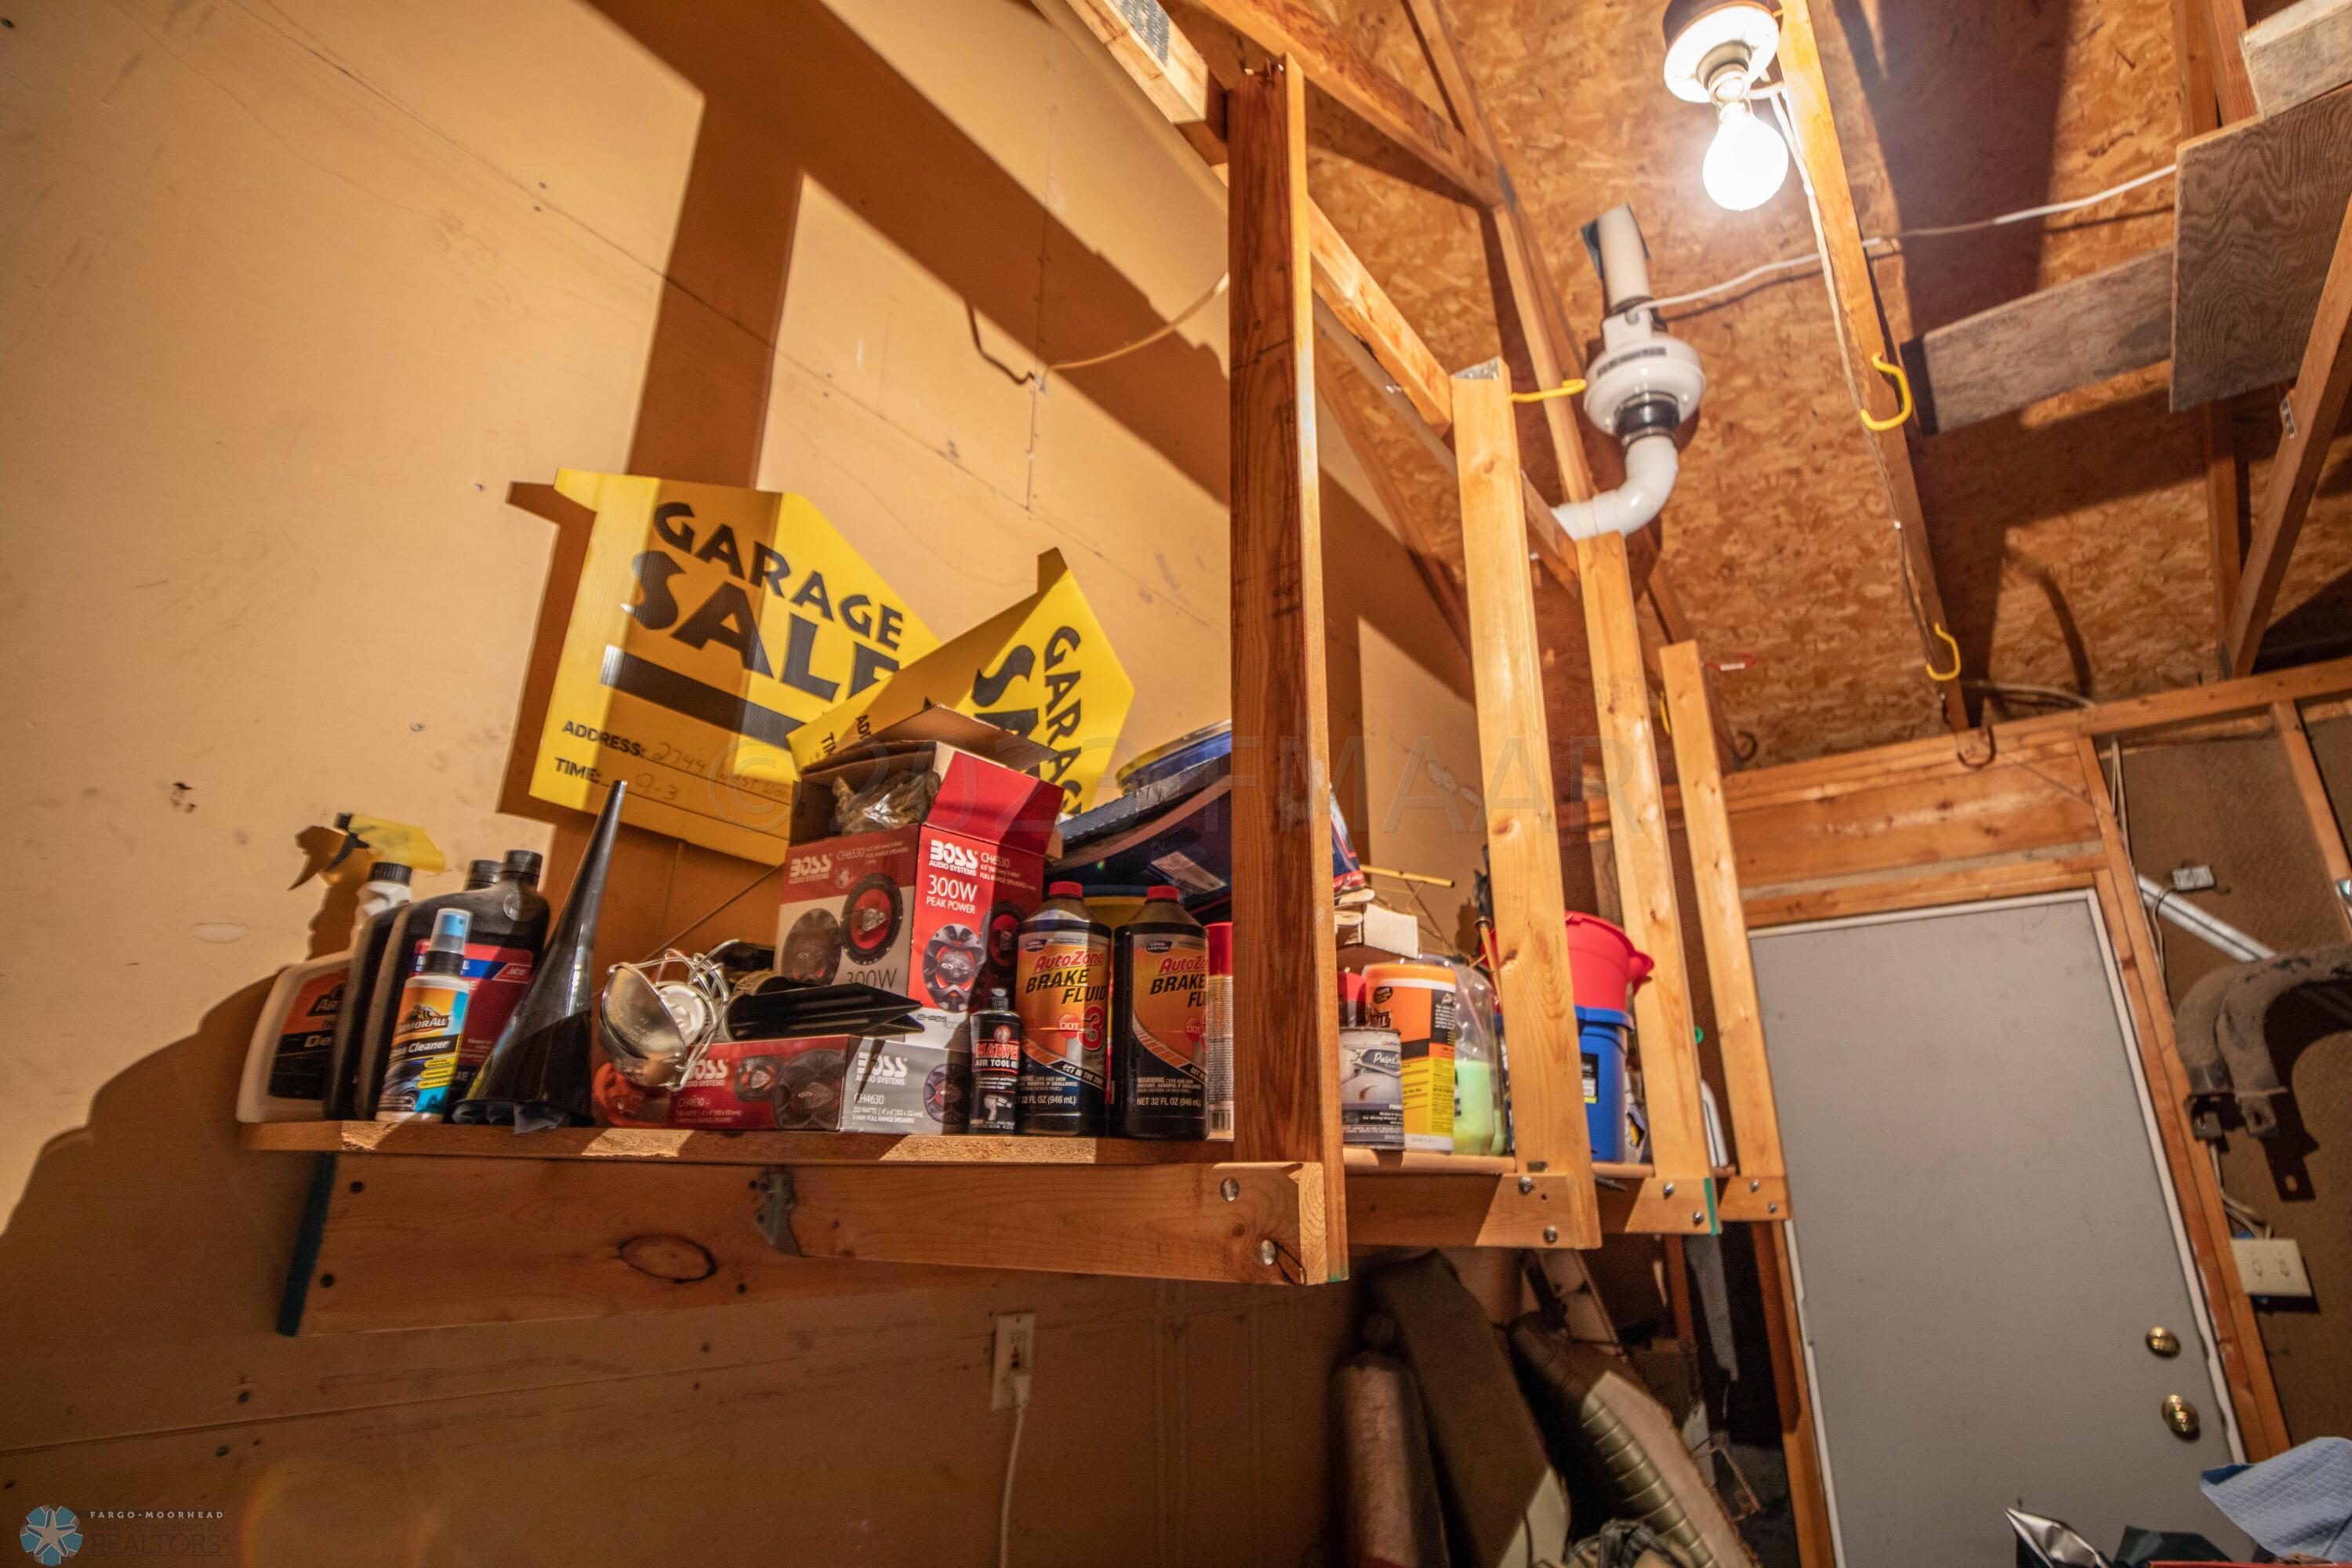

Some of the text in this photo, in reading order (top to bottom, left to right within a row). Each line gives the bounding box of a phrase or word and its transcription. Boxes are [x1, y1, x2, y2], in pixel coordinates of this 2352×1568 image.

[653, 501, 903, 652] GARAGE
[562, 720, 645, 758] ADDRESS:
[554, 756, 602, 785] TIME:
[931, 840, 978, 869] BOSS
[789, 854, 832, 877] BOSS
[928, 859, 977, 877] AUDIO SYSTEMS
[927, 875, 978, 902] 300W
[926, 896, 975, 914] PEAK POWER
[1033, 950, 1104, 973] AutoZone
[1158, 955, 1207, 975] AutoZo
[1025, 969, 1089, 994] BRAKE
[1149, 973, 1206, 995] BRAKE
[1062, 985, 1106, 1004] FLUID
[1059, 1022, 1080, 1030] DOT
[1077, 1005, 1105, 1051] 3
[408, 1040, 451, 1053] Cleaner
[975, 1043, 1020, 1061] MARVE
[688, 1059, 728, 1080] OSS
[991, 1059, 1011, 1068] TOOL
[877, 1076, 906, 1086] SYSTEMS
